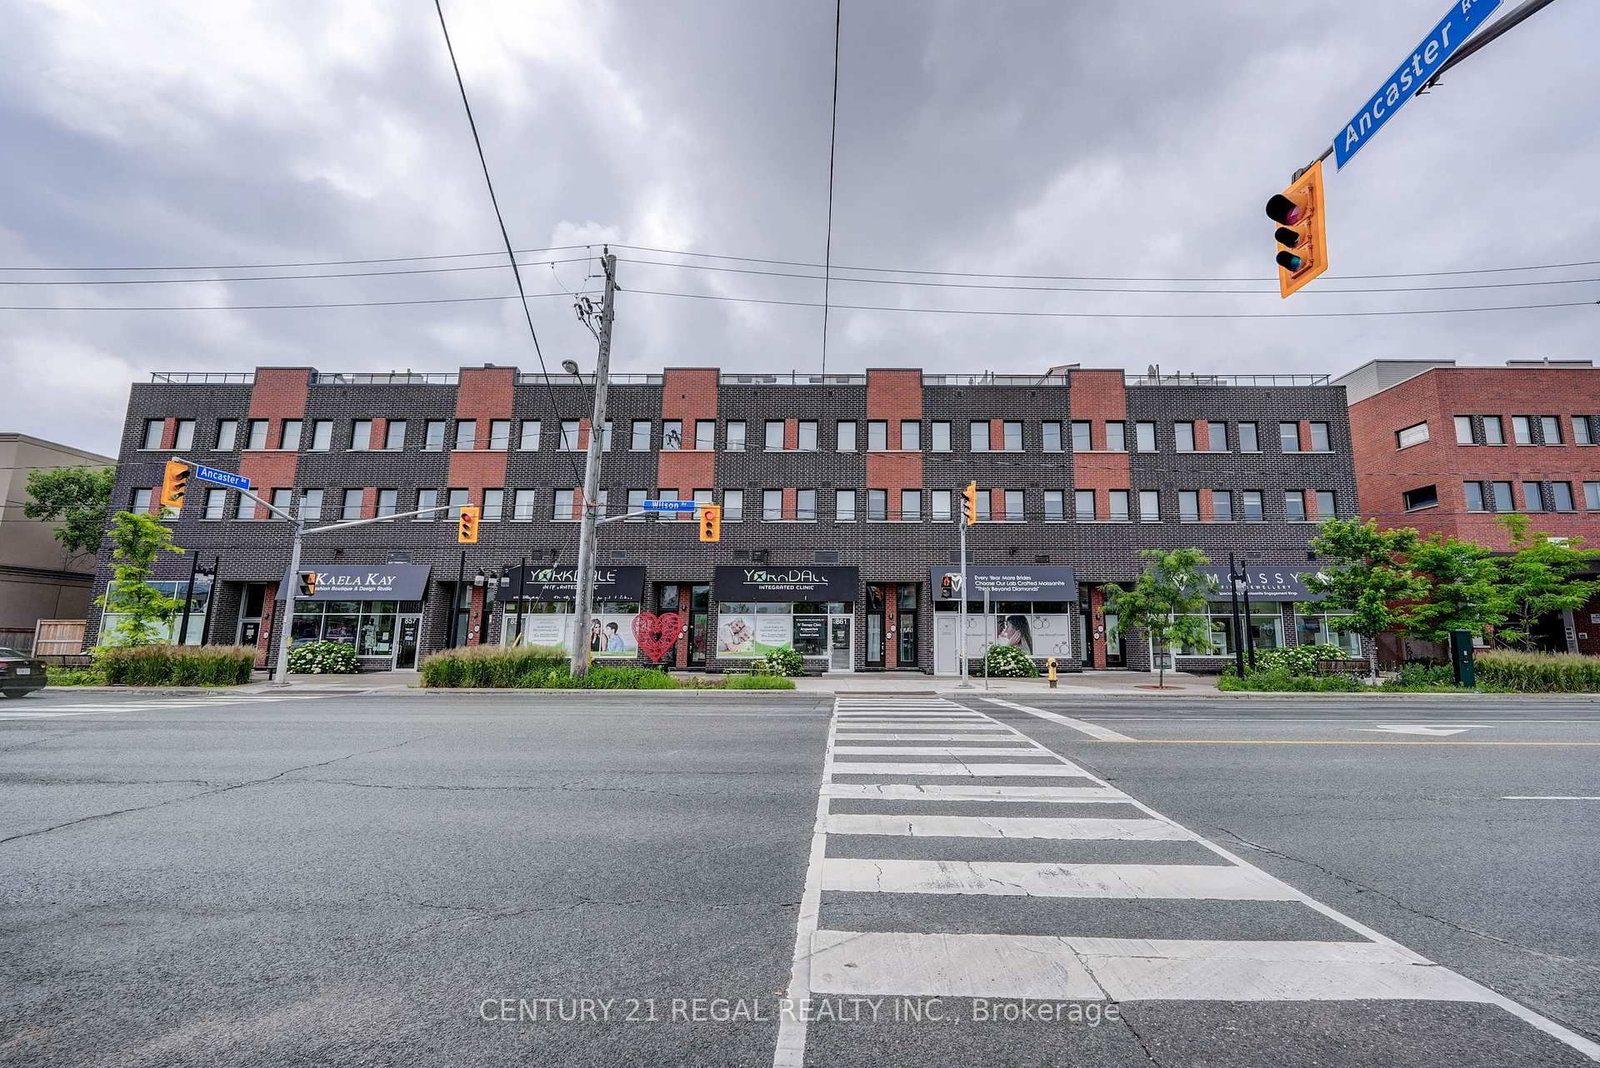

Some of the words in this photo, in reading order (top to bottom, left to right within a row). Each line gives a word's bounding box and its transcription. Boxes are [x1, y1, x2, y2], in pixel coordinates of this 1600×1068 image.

[1345, 21, 1453, 153] Ancaster
[200, 467, 239, 484] Ancaster
[652, 501, 679, 509] Wilson
[315, 573, 361, 585] KAELA
[364, 573, 396, 585] KAY
[530, 569, 616, 582] YORKLE
